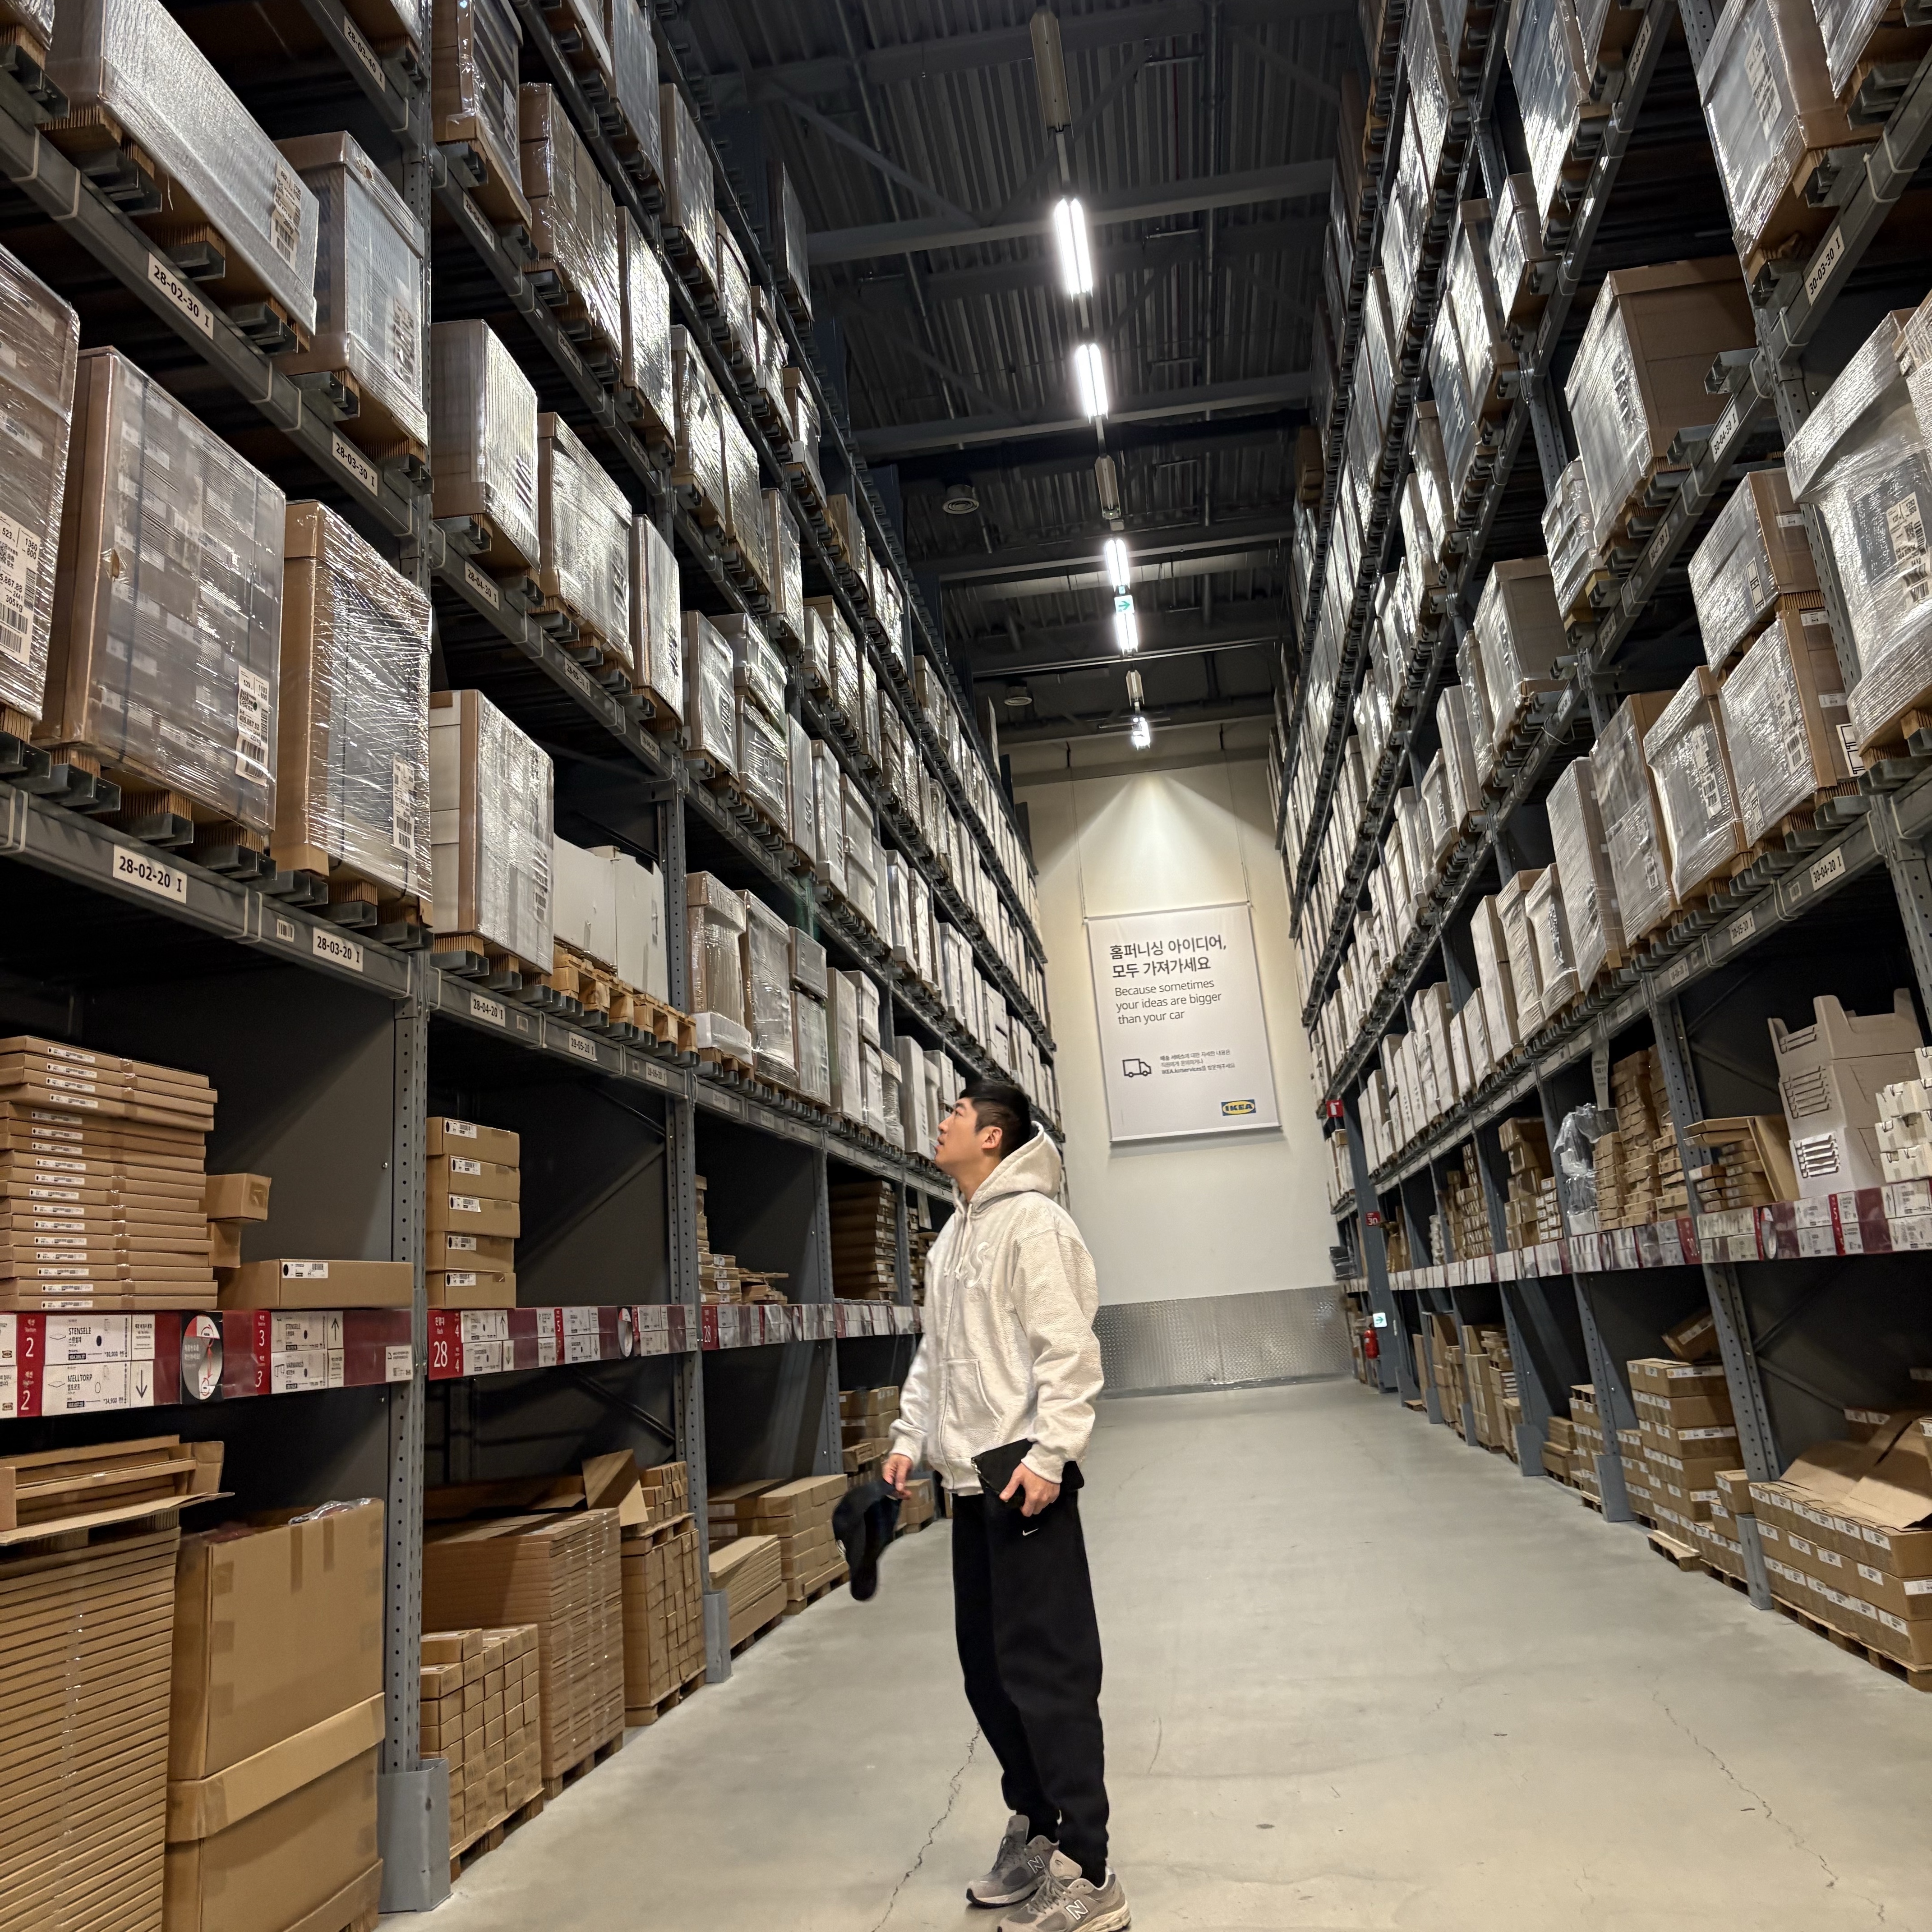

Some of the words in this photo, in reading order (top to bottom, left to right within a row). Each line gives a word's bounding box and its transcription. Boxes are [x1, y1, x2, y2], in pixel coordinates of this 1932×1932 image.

[1809, 248, 1835, 295] 30-03-30
[154, 265, 199, 317] 28-02-30
[336, 442, 368, 480] 28-03-30
[2, 528, 12, 539] 523
[25, 538, 37, 551] 1360
[27, 548, 37, 560] 800
[119, 856, 171, 888] 28-02-20
[317, 936, 352, 960] 28-03-20
[1110, 940, 1163, 960] 홈퍼니싱
[1168, 934, 1227, 954] 아이디어,
[1112, 963, 1139, 978] 모두
[1143, 957, 1211, 976] 가져가세요
[1115, 985, 1156, 996] Because
[1159, 980, 1215, 992] sometimes
[474, 998, 498, 1017] 28-04-20
[1116, 1001, 1139, 1013] your
[1142, 998, 1168, 1008] ideas
[1171, 997, 1187, 1005] are
[1189, 993, 1222, 1005] bigger
[1118, 1015, 1141, 1025] than
[1144, 1012, 1167, 1025] your
[1169, 1011, 1185, 1020] car
[26, 1337, 34, 1357] 2
[259, 1329, 265, 1346] 3
[433, 1340, 448, 1368] 28
[255, 1370, 263, 1388] 3
[20, 1390, 31, 1411] 2
[1027, 1855, 1046, 1874] N
[1065, 1899, 1089, 1920] N
